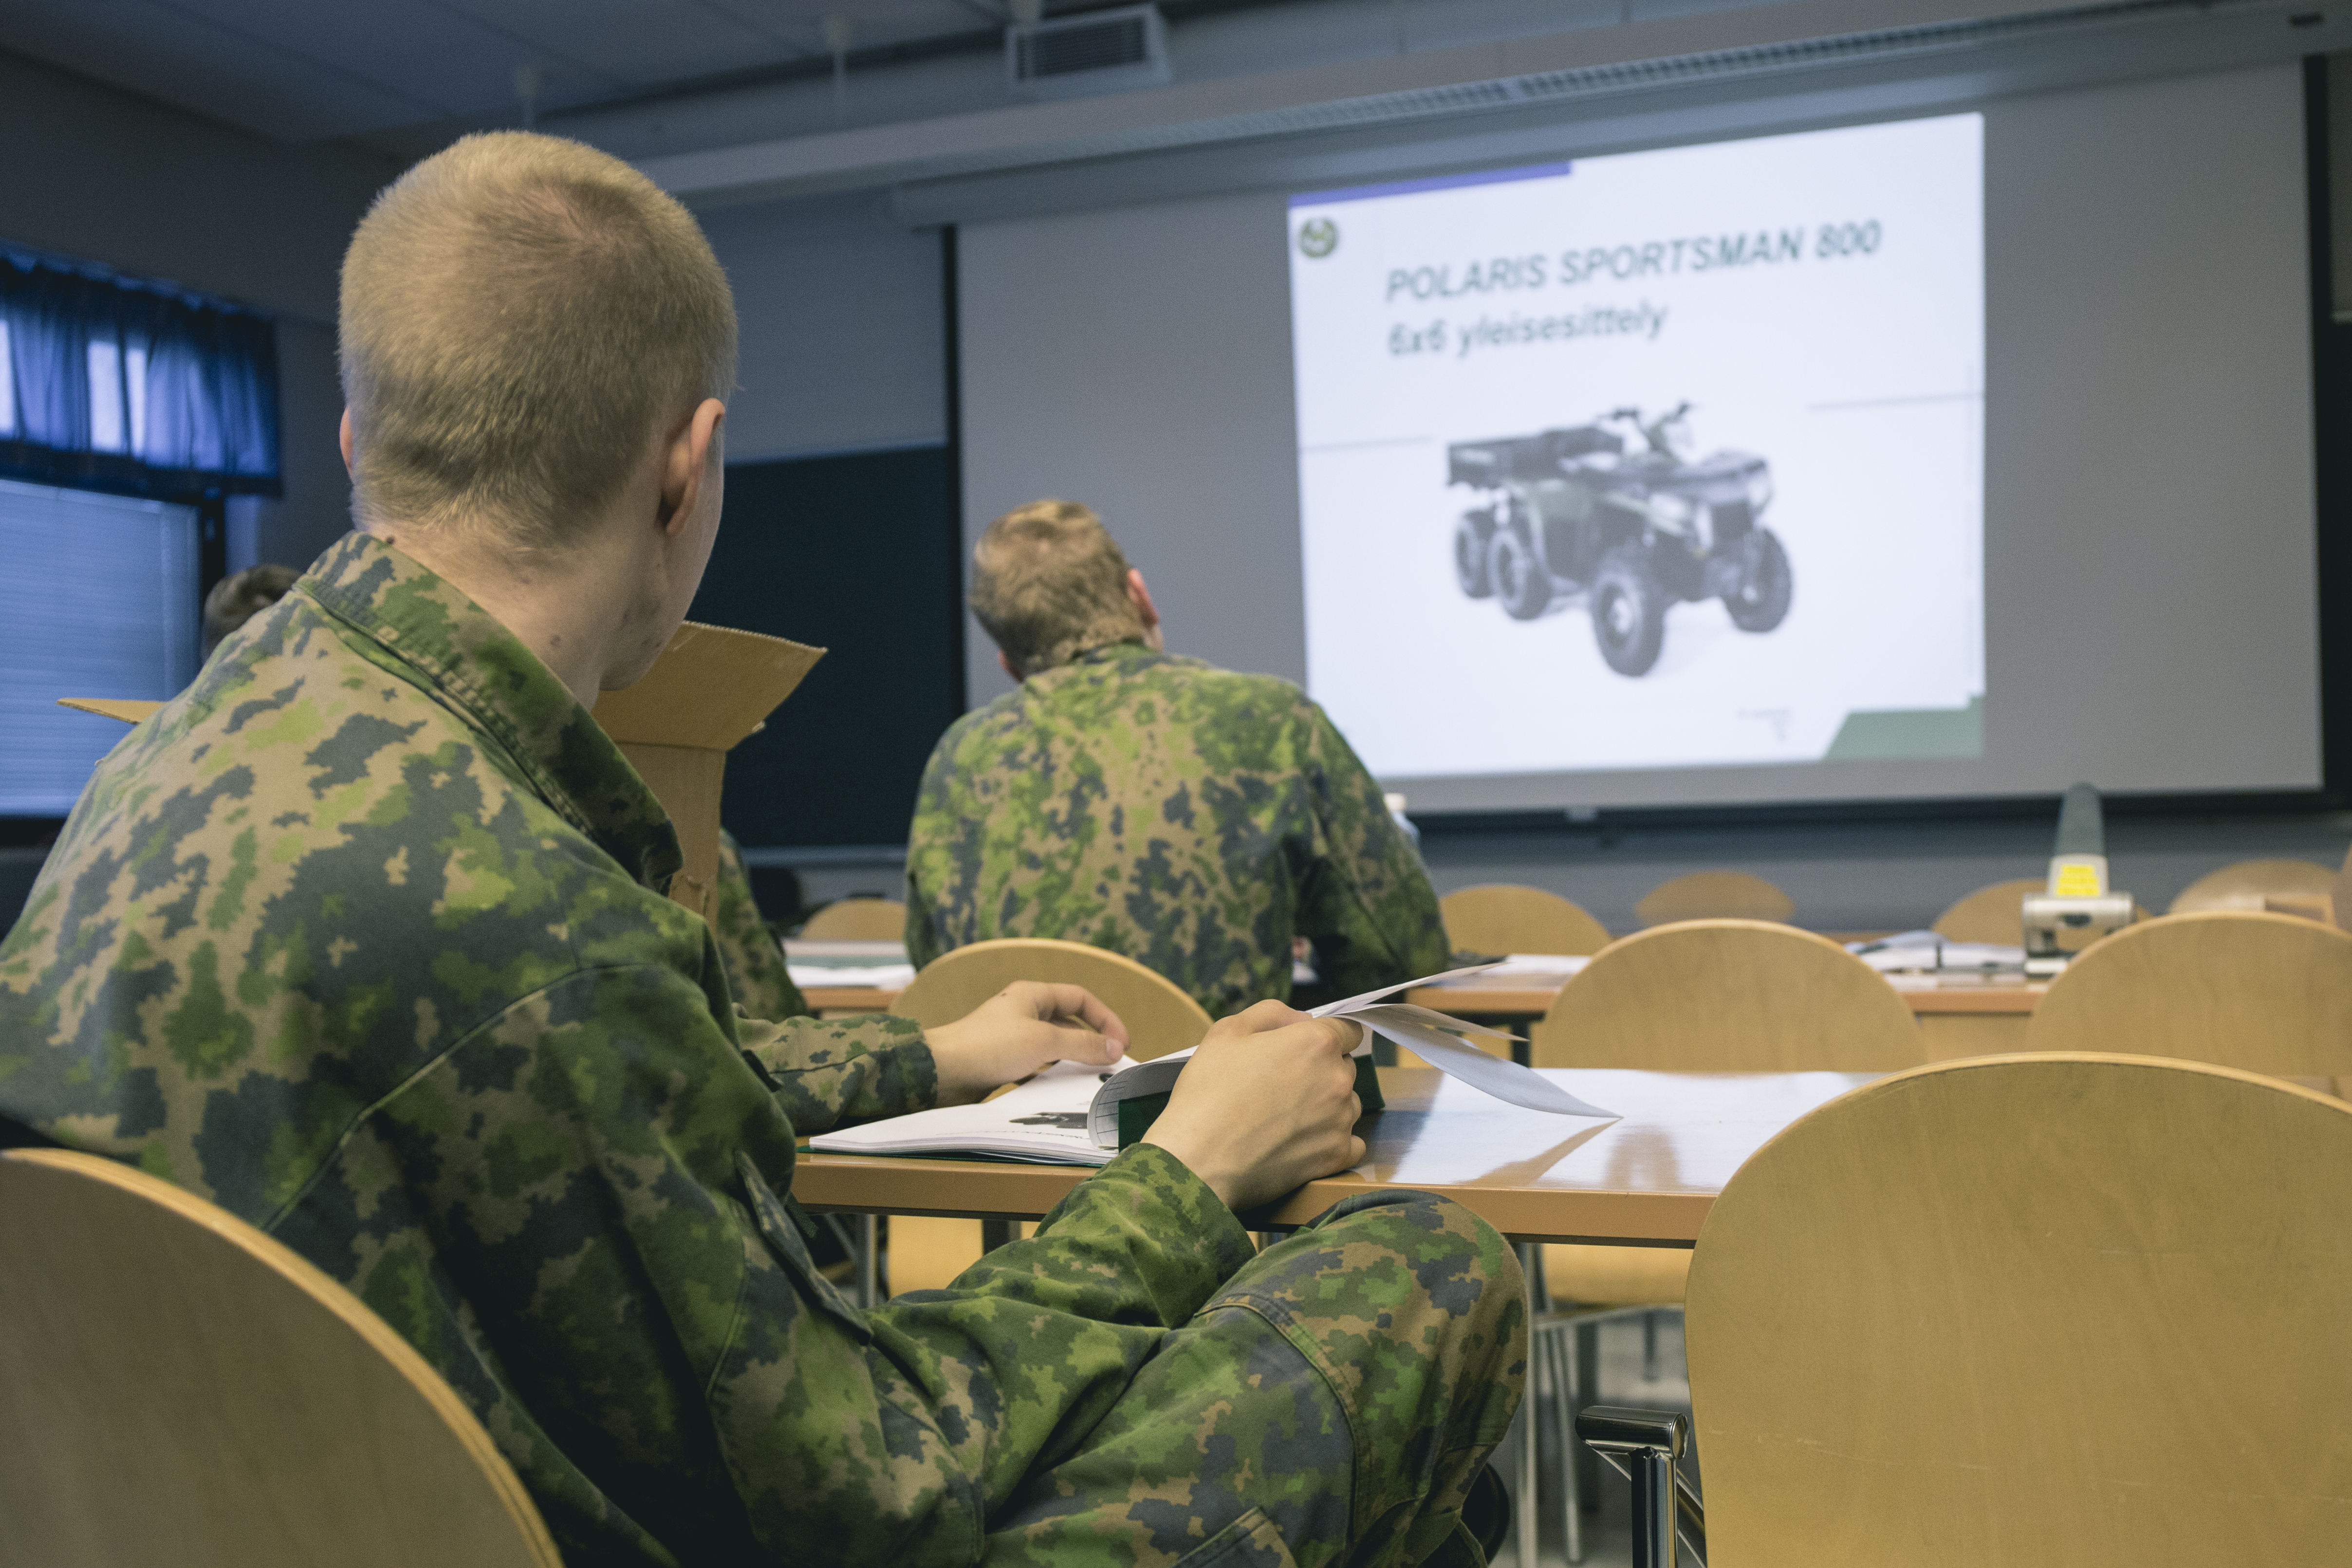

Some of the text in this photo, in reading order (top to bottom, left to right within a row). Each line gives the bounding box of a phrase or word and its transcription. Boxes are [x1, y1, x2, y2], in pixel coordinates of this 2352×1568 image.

[1386, 219, 1882, 302] POLARIS SPORTSMAN 800
[1389, 301, 1669, 360] 6x6 yleisesittely
